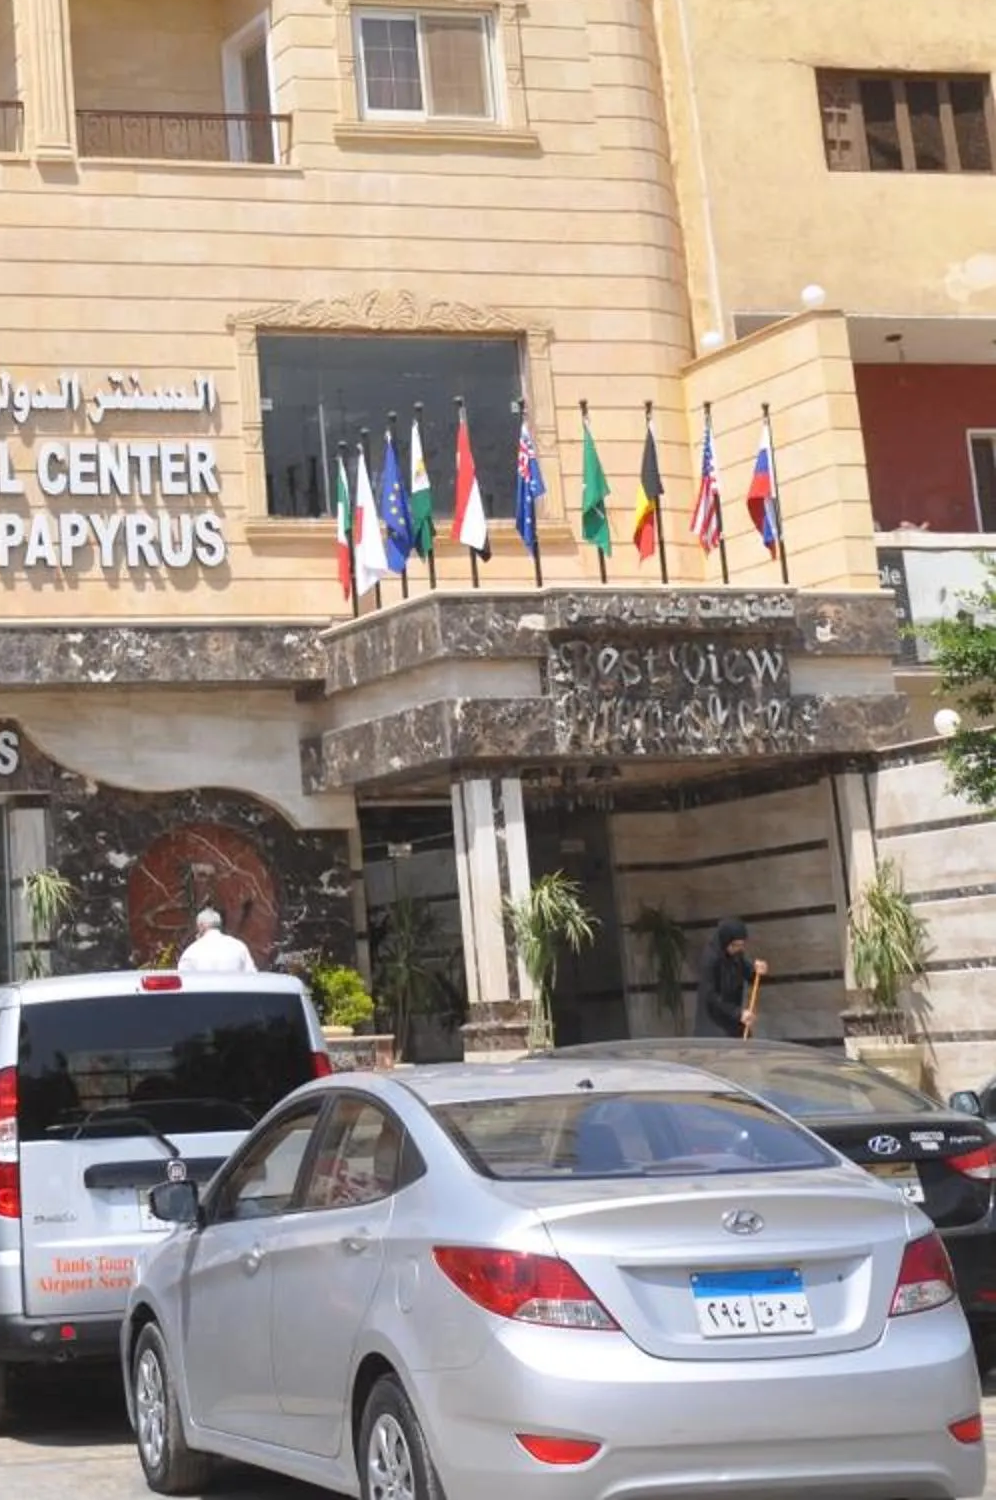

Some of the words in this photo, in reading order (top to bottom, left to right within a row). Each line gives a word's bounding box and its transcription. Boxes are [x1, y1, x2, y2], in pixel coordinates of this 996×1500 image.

[87, 371, 216, 424] السنتر
[36, 440, 221, 497] CENTER
[559, 640, 670, 687] Best
[670, 642, 784, 685] View
